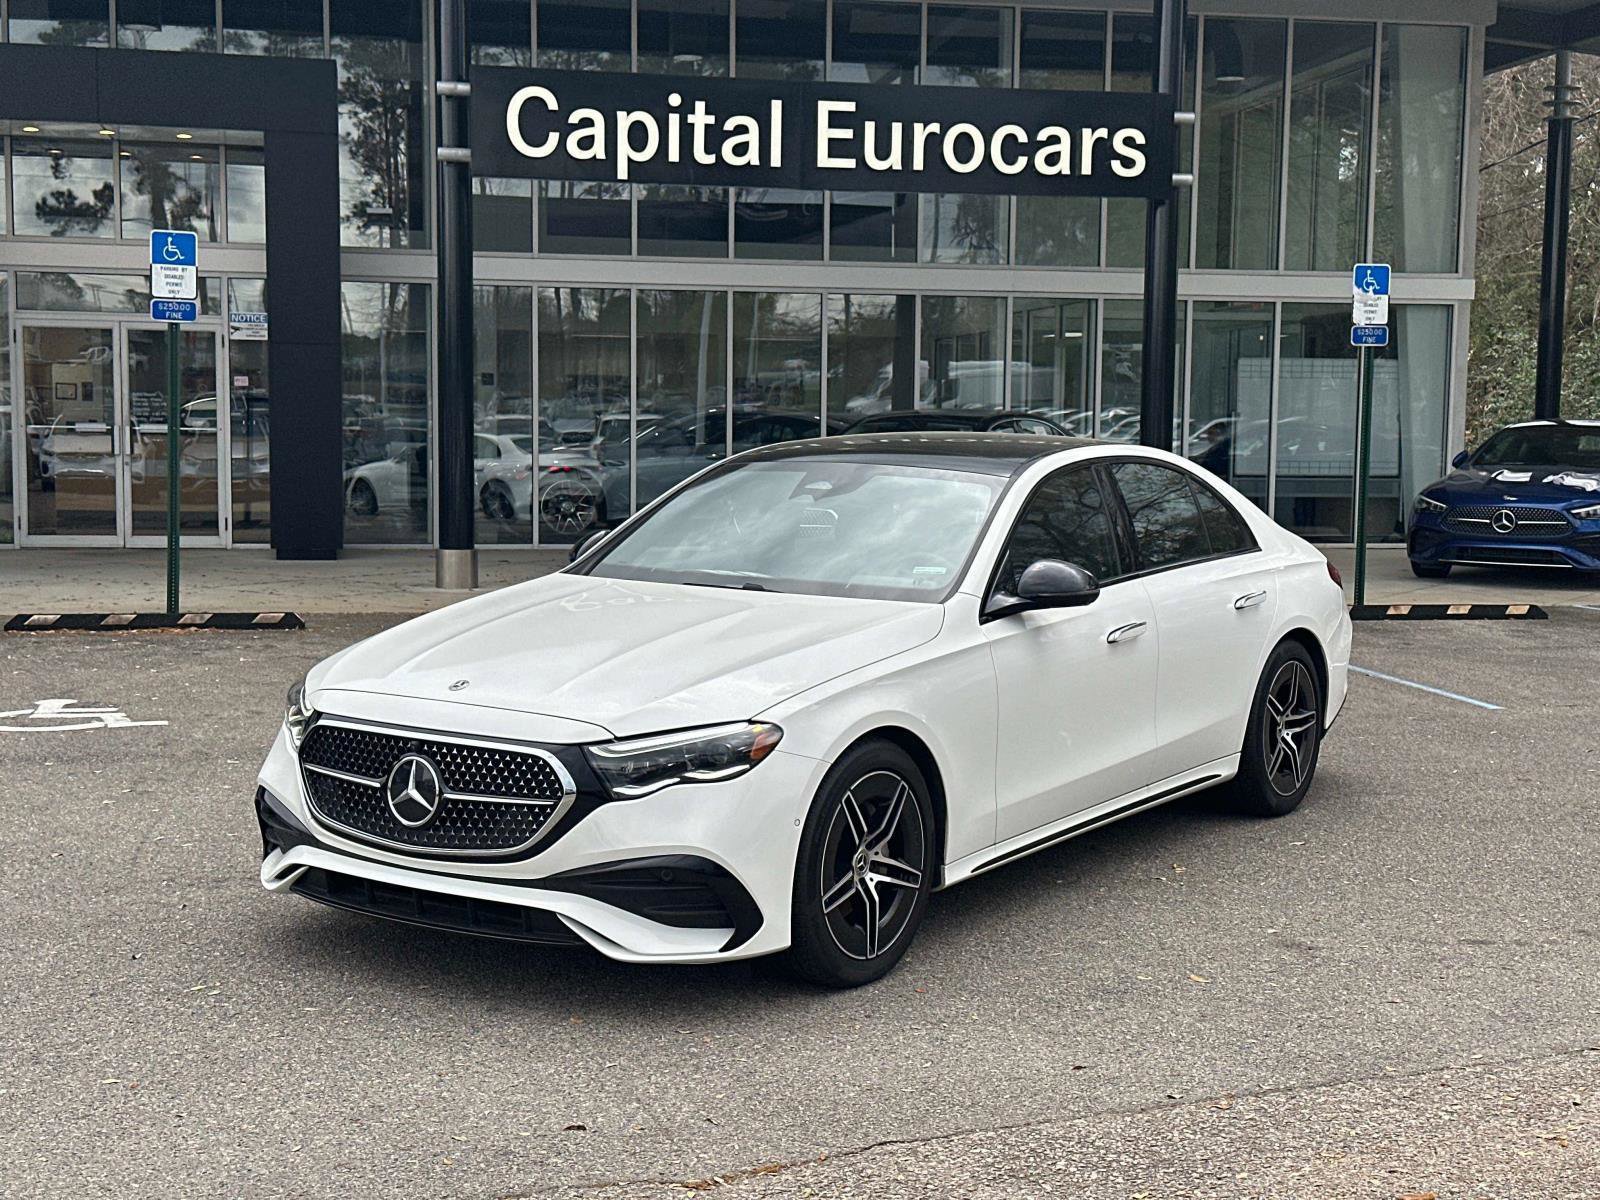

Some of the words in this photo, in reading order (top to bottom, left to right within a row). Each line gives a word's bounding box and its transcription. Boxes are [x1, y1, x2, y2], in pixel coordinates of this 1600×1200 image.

[506, 85, 783, 180] Capital
[816, 100, 1147, 178] Eurocars
[158, 302, 191, 311] $250.00
[165, 311, 183, 319] FINE
[231, 314, 266, 322] NOTICE
[1357, 328, 1383, 336] $250.00
